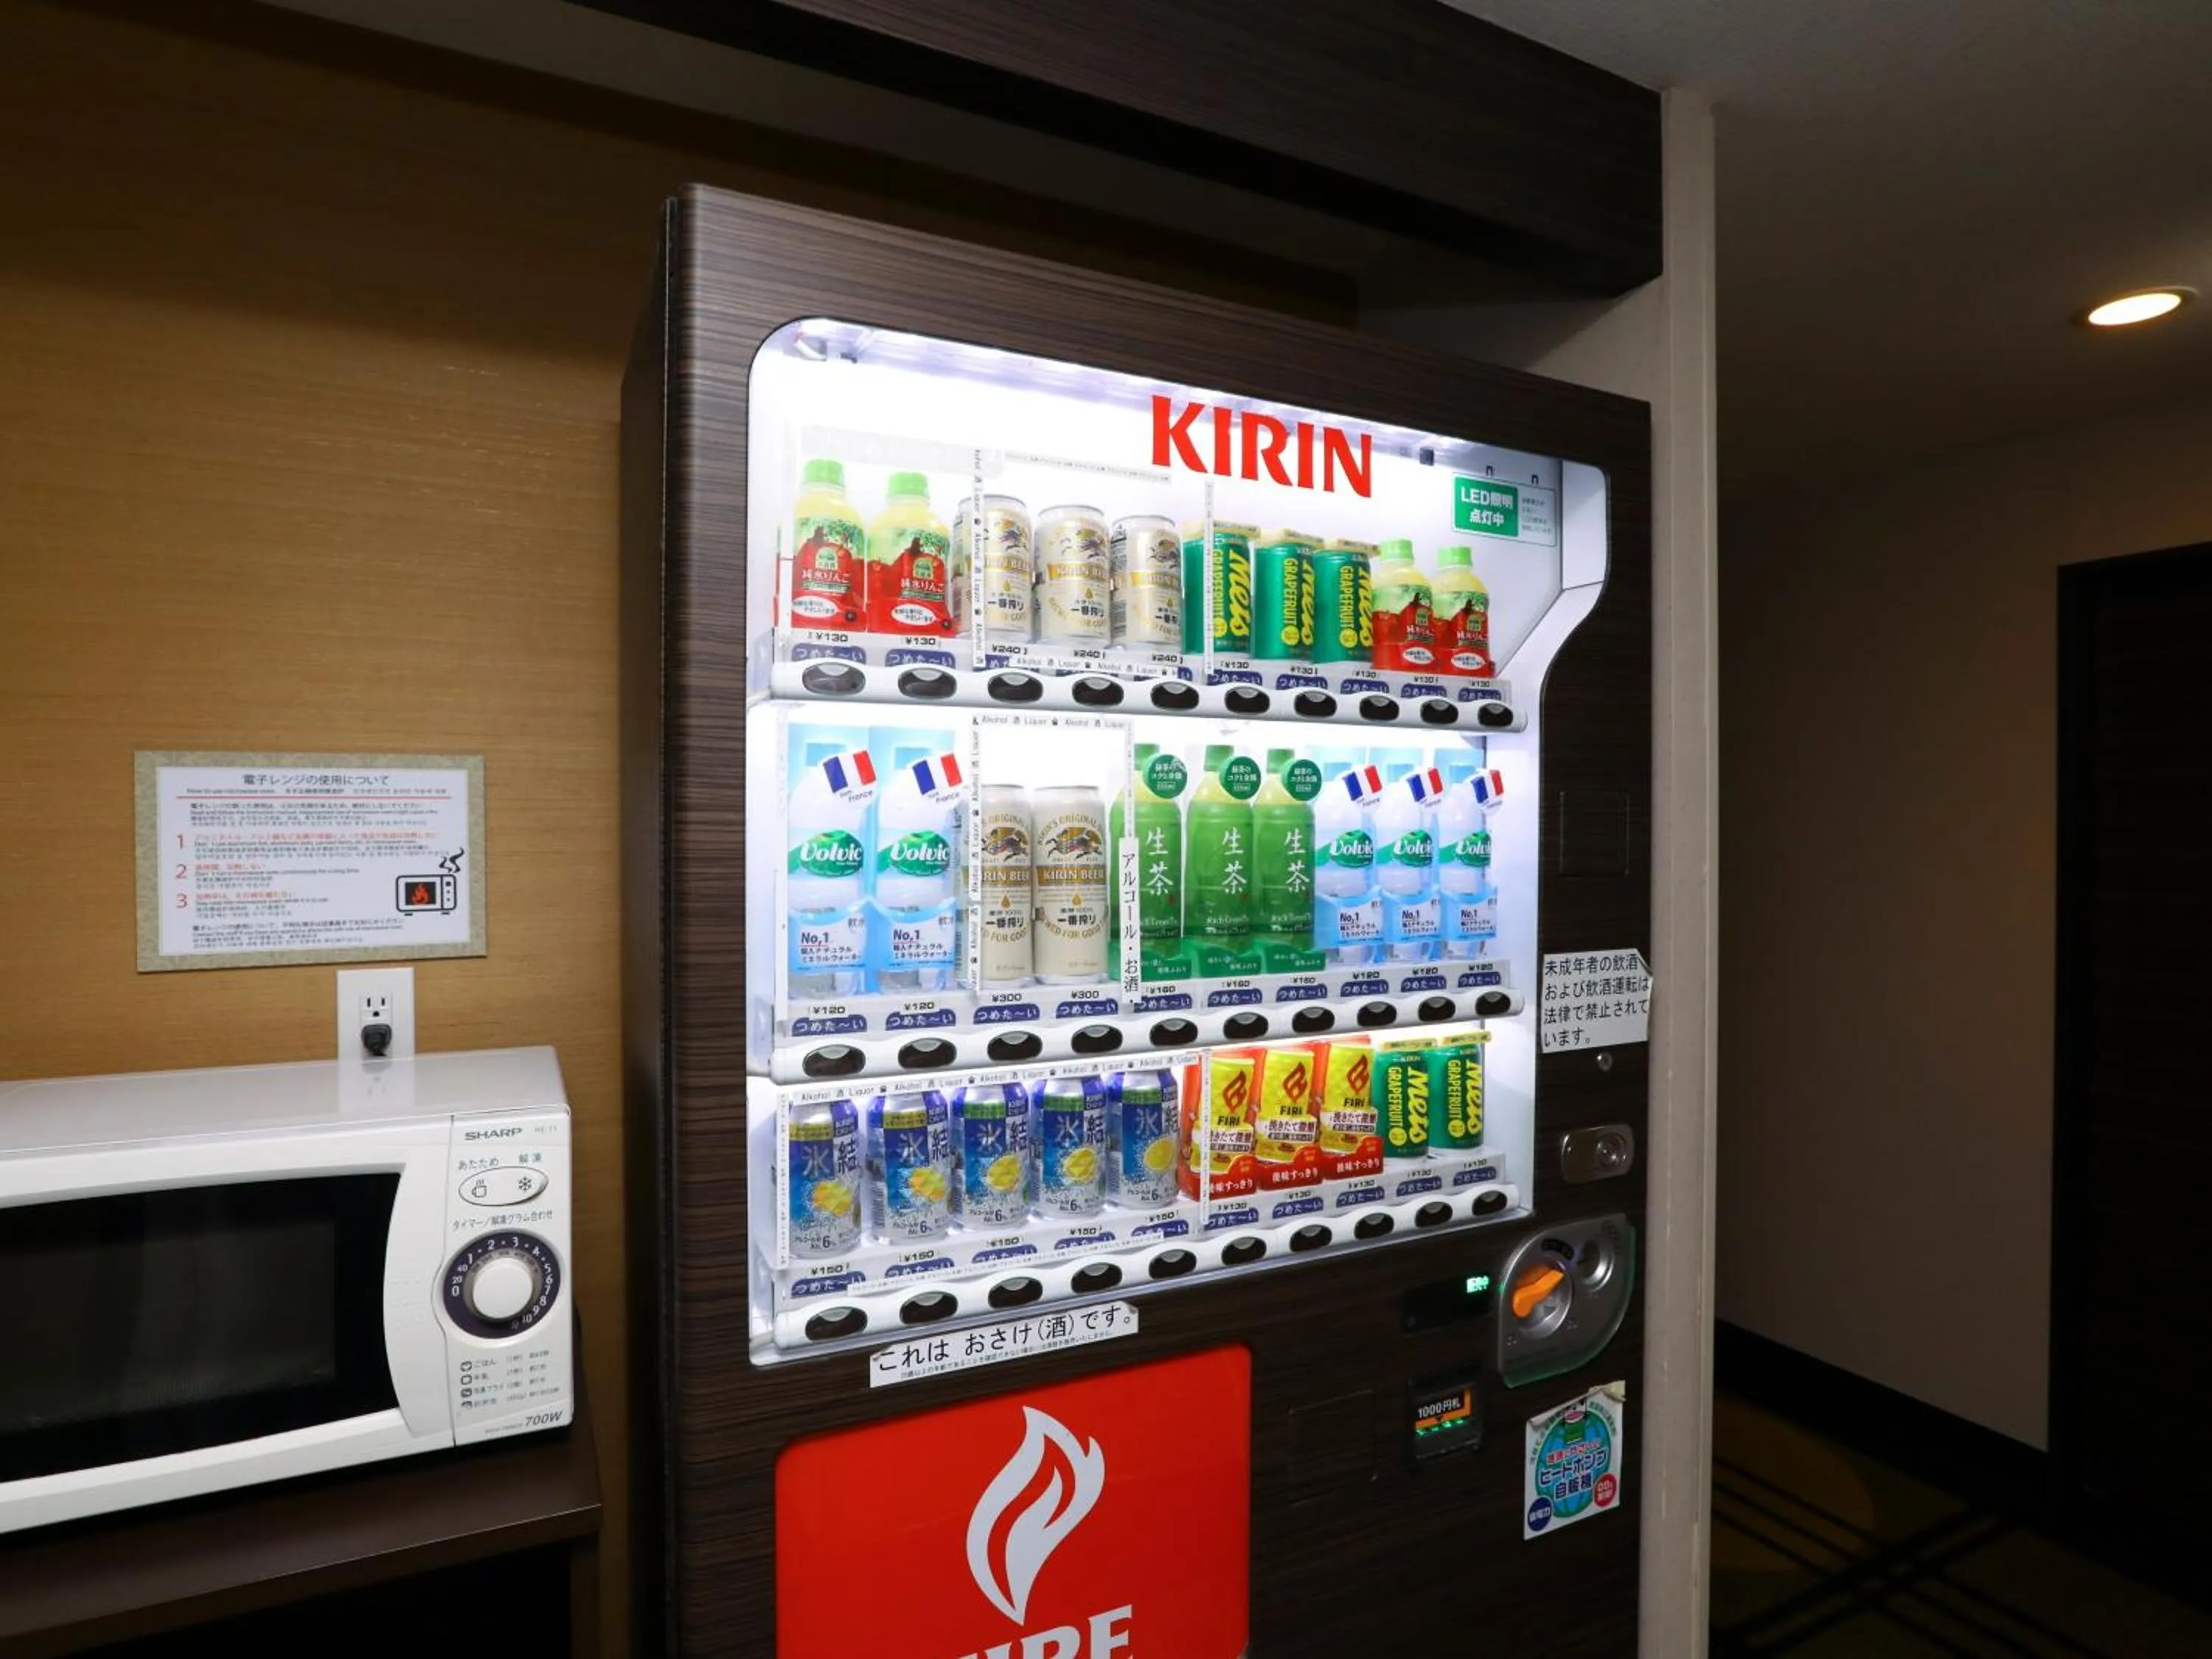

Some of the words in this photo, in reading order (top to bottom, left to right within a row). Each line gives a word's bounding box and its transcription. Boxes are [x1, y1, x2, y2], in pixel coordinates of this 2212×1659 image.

[1152, 394, 1372, 498] KIRIN
[1284, 559, 1298, 625] GRAPEFRUIT
[1340, 566, 1354, 629] GRAPEFRUIT
[816, 633, 848, 642] ¥130
[905, 637, 936, 646] ¥130
[992, 644, 1022, 654] ¥240
[1074, 650, 1100, 658] ¥240
[243, 773, 389, 787] 電子レンジの使用について
[177, 834, 184, 849] 1
[801, 842, 862, 862] Volvic
[891, 842, 949, 862] Volvic
[1147, 827, 1173, 896] 生茶
[1221, 827, 1247, 894] 生茶
[1284, 828, 1310, 893] 生茶
[175, 863, 187, 879] 2
[981, 871, 1006, 882] RIN
[1044, 869, 1077, 881] KIRIN
[1082, 868, 1105, 880] BEER
[176, 894, 188, 909] 3
[986, 917, 1024, 928] 一番搾り
[1057, 914, 1096, 925] 一番搾り
[1545, 953, 1638, 976] 未成年者の飲酒
[1071, 990, 1099, 999] ¥300
[1545, 976, 1649, 1001] および飲酒運転は
[904, 1001, 935, 1010] ¥120
[992, 994, 1022, 1003] ¥300
[813, 1006, 846, 1015] ¥120
[1544, 999, 1649, 1024] 法律で禁止されて
[1545, 1027, 1590, 1047] います。
[1388, 1067, 1402, 1127] GRAPEFRUIT
[1447, 1060, 1461, 1120] GRAPEFRUIT
[465, 1127, 523, 1141] SHARP
[457, 1157, 499, 1171] あたため
[487, 1239, 495, 1250] 2
[512, 1237, 519, 1248] 3
[532, 1246, 540, 1256] 4
[467, 1253, 473, 1264] 1
[544, 1264, 552, 1273] 5
[452, 1275, 462, 1284] 20
[546, 1275, 553, 1284] 6
[452, 1285, 460, 1296] 0
[545, 1285, 552, 1295] 7
[540, 1295, 546, 1307] 8
[532, 1305, 540, 1316] 9
[523, 1313, 533, 1323] 10
[879, 1338, 950, 1371] これは
[526, 1411, 563, 1427] 700W
[1540, 1449, 1608, 1486] ヒートポンプ
[1554, 1472, 1593, 1500] 自販機
[959, 1604, 1133, 1659] RE
